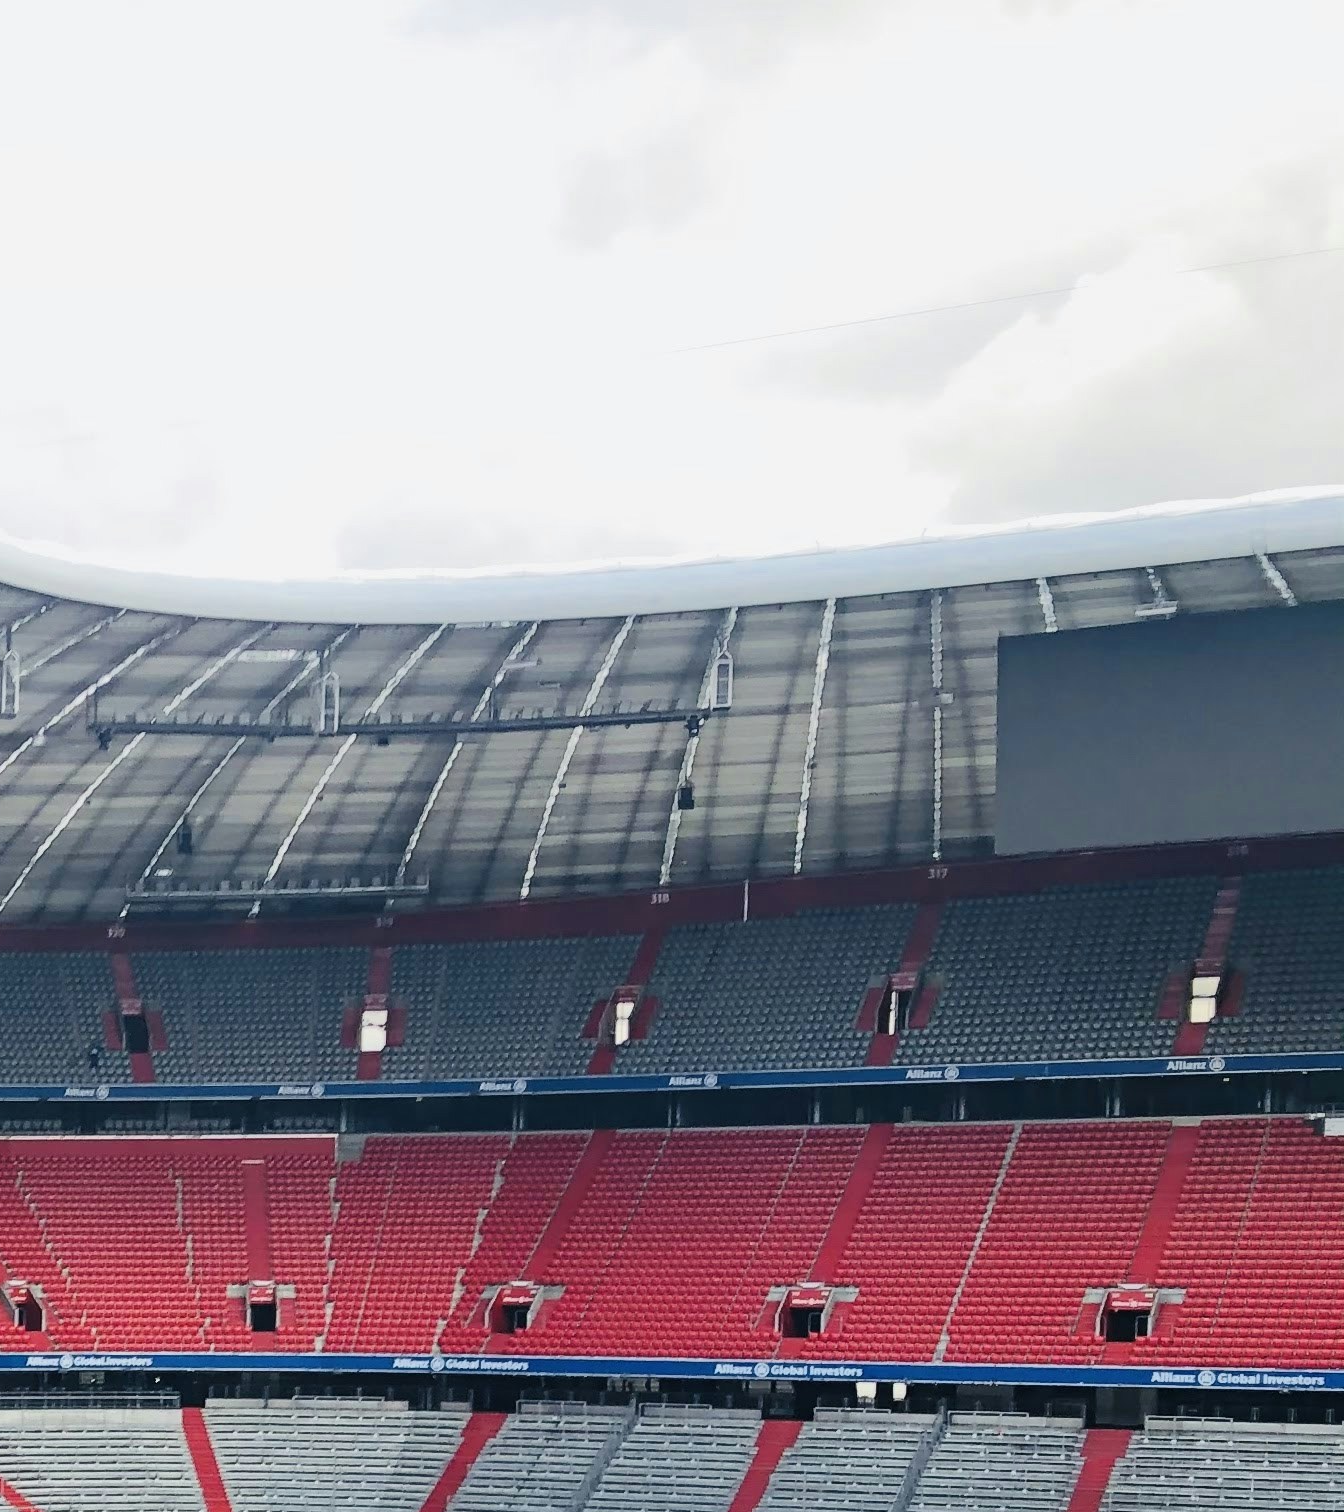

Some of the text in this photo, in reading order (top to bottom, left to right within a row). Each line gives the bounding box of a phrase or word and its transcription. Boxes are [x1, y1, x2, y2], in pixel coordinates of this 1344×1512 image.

[927, 868, 948, 880] 317
[1166, 1060, 1207, 1071] Allianz
[906, 1069, 942, 1079] Allianz
[669, 1075, 703, 1086] Allianz
[74, 1356, 105, 1367] Global
[105, 1356, 153, 1367] Investors
[393, 1358, 529, 1371] Allianz Global Investors
[714, 1364, 863, 1377] Allianz Global Investors
[1151, 1371, 1325, 1386] Allianz Global Investors
